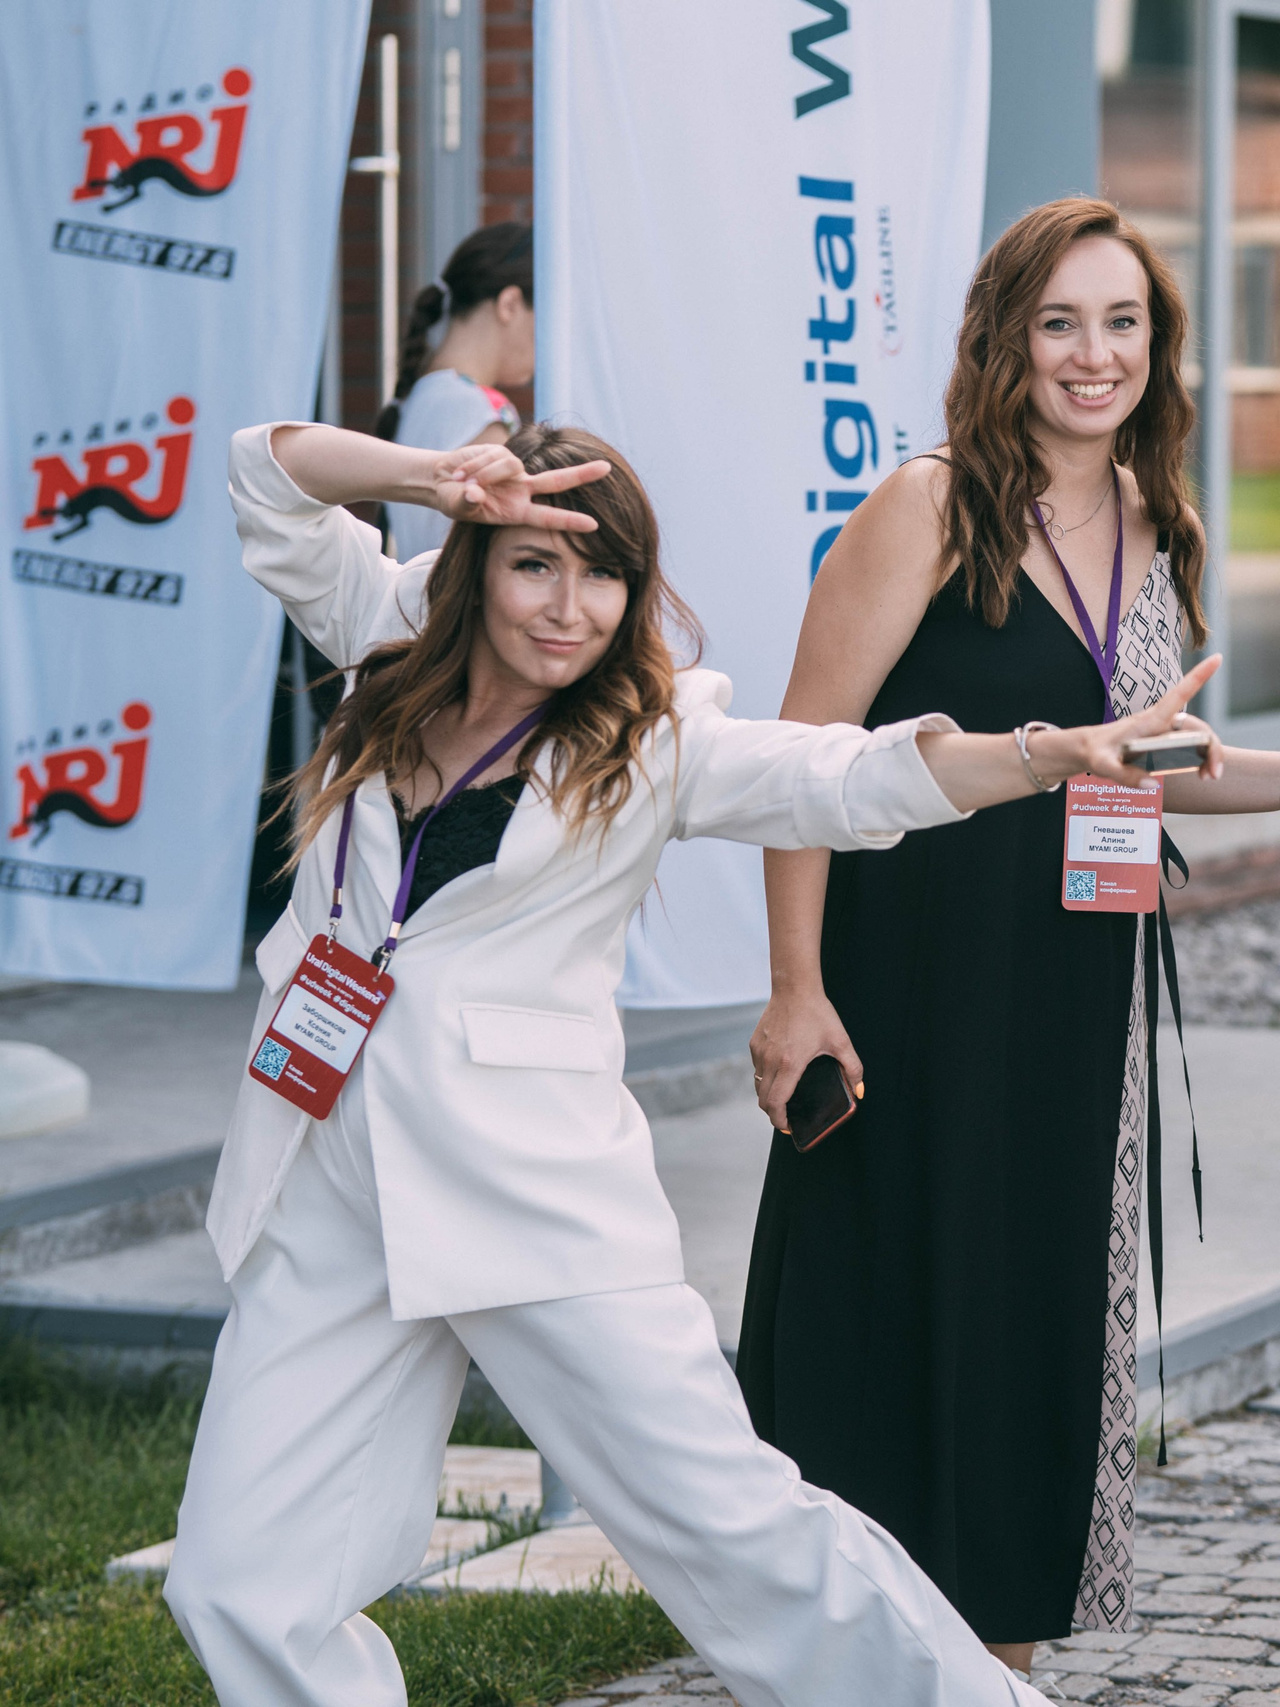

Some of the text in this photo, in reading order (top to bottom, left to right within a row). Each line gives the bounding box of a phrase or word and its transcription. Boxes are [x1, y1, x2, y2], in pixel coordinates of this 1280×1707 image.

[56, 221, 168, 267] ENERGY
[15, 550, 119, 594] ENERGY
[1070, 783, 1088, 793] Ural
[1088, 784, 1116, 795] Digital
[1072, 803, 1156, 815] #udweek #digiweek
[1093, 825, 1135, 835] Гневашева
[1101, 836, 1126, 844] Алина
[1112, 846, 1138, 854] GROUP
[306, 952, 324, 969] Ural
[321, 961, 348, 984] Digital
[345, 976, 381, 1005] Weekend
[300, 974, 333, 999] #udweek
[333, 995, 372, 1023] #digiweek
[294, 1023, 337, 1051] MYAMI GROUP
[308, 1019, 331, 1037] Ксения
